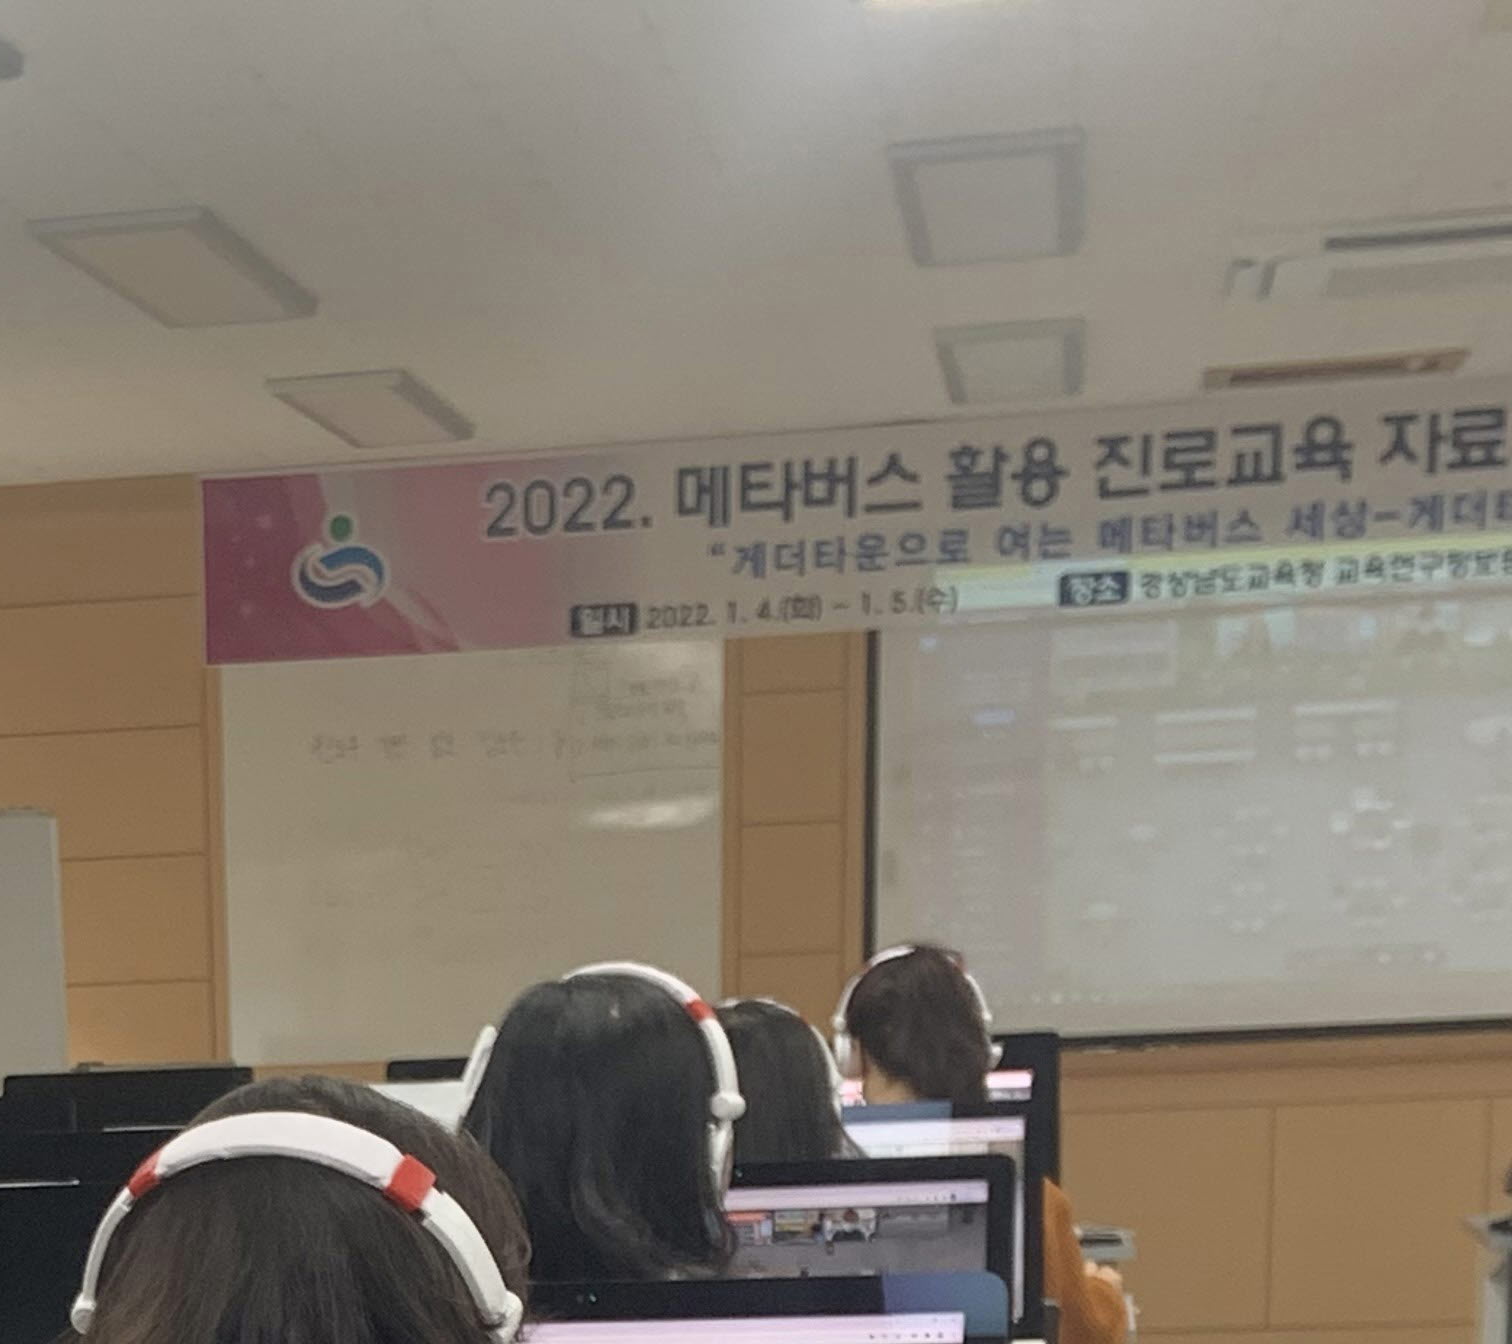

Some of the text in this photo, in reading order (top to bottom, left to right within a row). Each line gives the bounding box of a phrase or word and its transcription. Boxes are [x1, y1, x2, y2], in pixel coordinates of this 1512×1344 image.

[485, 407, 1507, 539] 2022. 메타버스 활용 진로교육 자료
[996, 521, 1073, 562] 여는
[1098, 507, 1264, 556] 메타버스
[646, 602, 717, 630] 2022.
